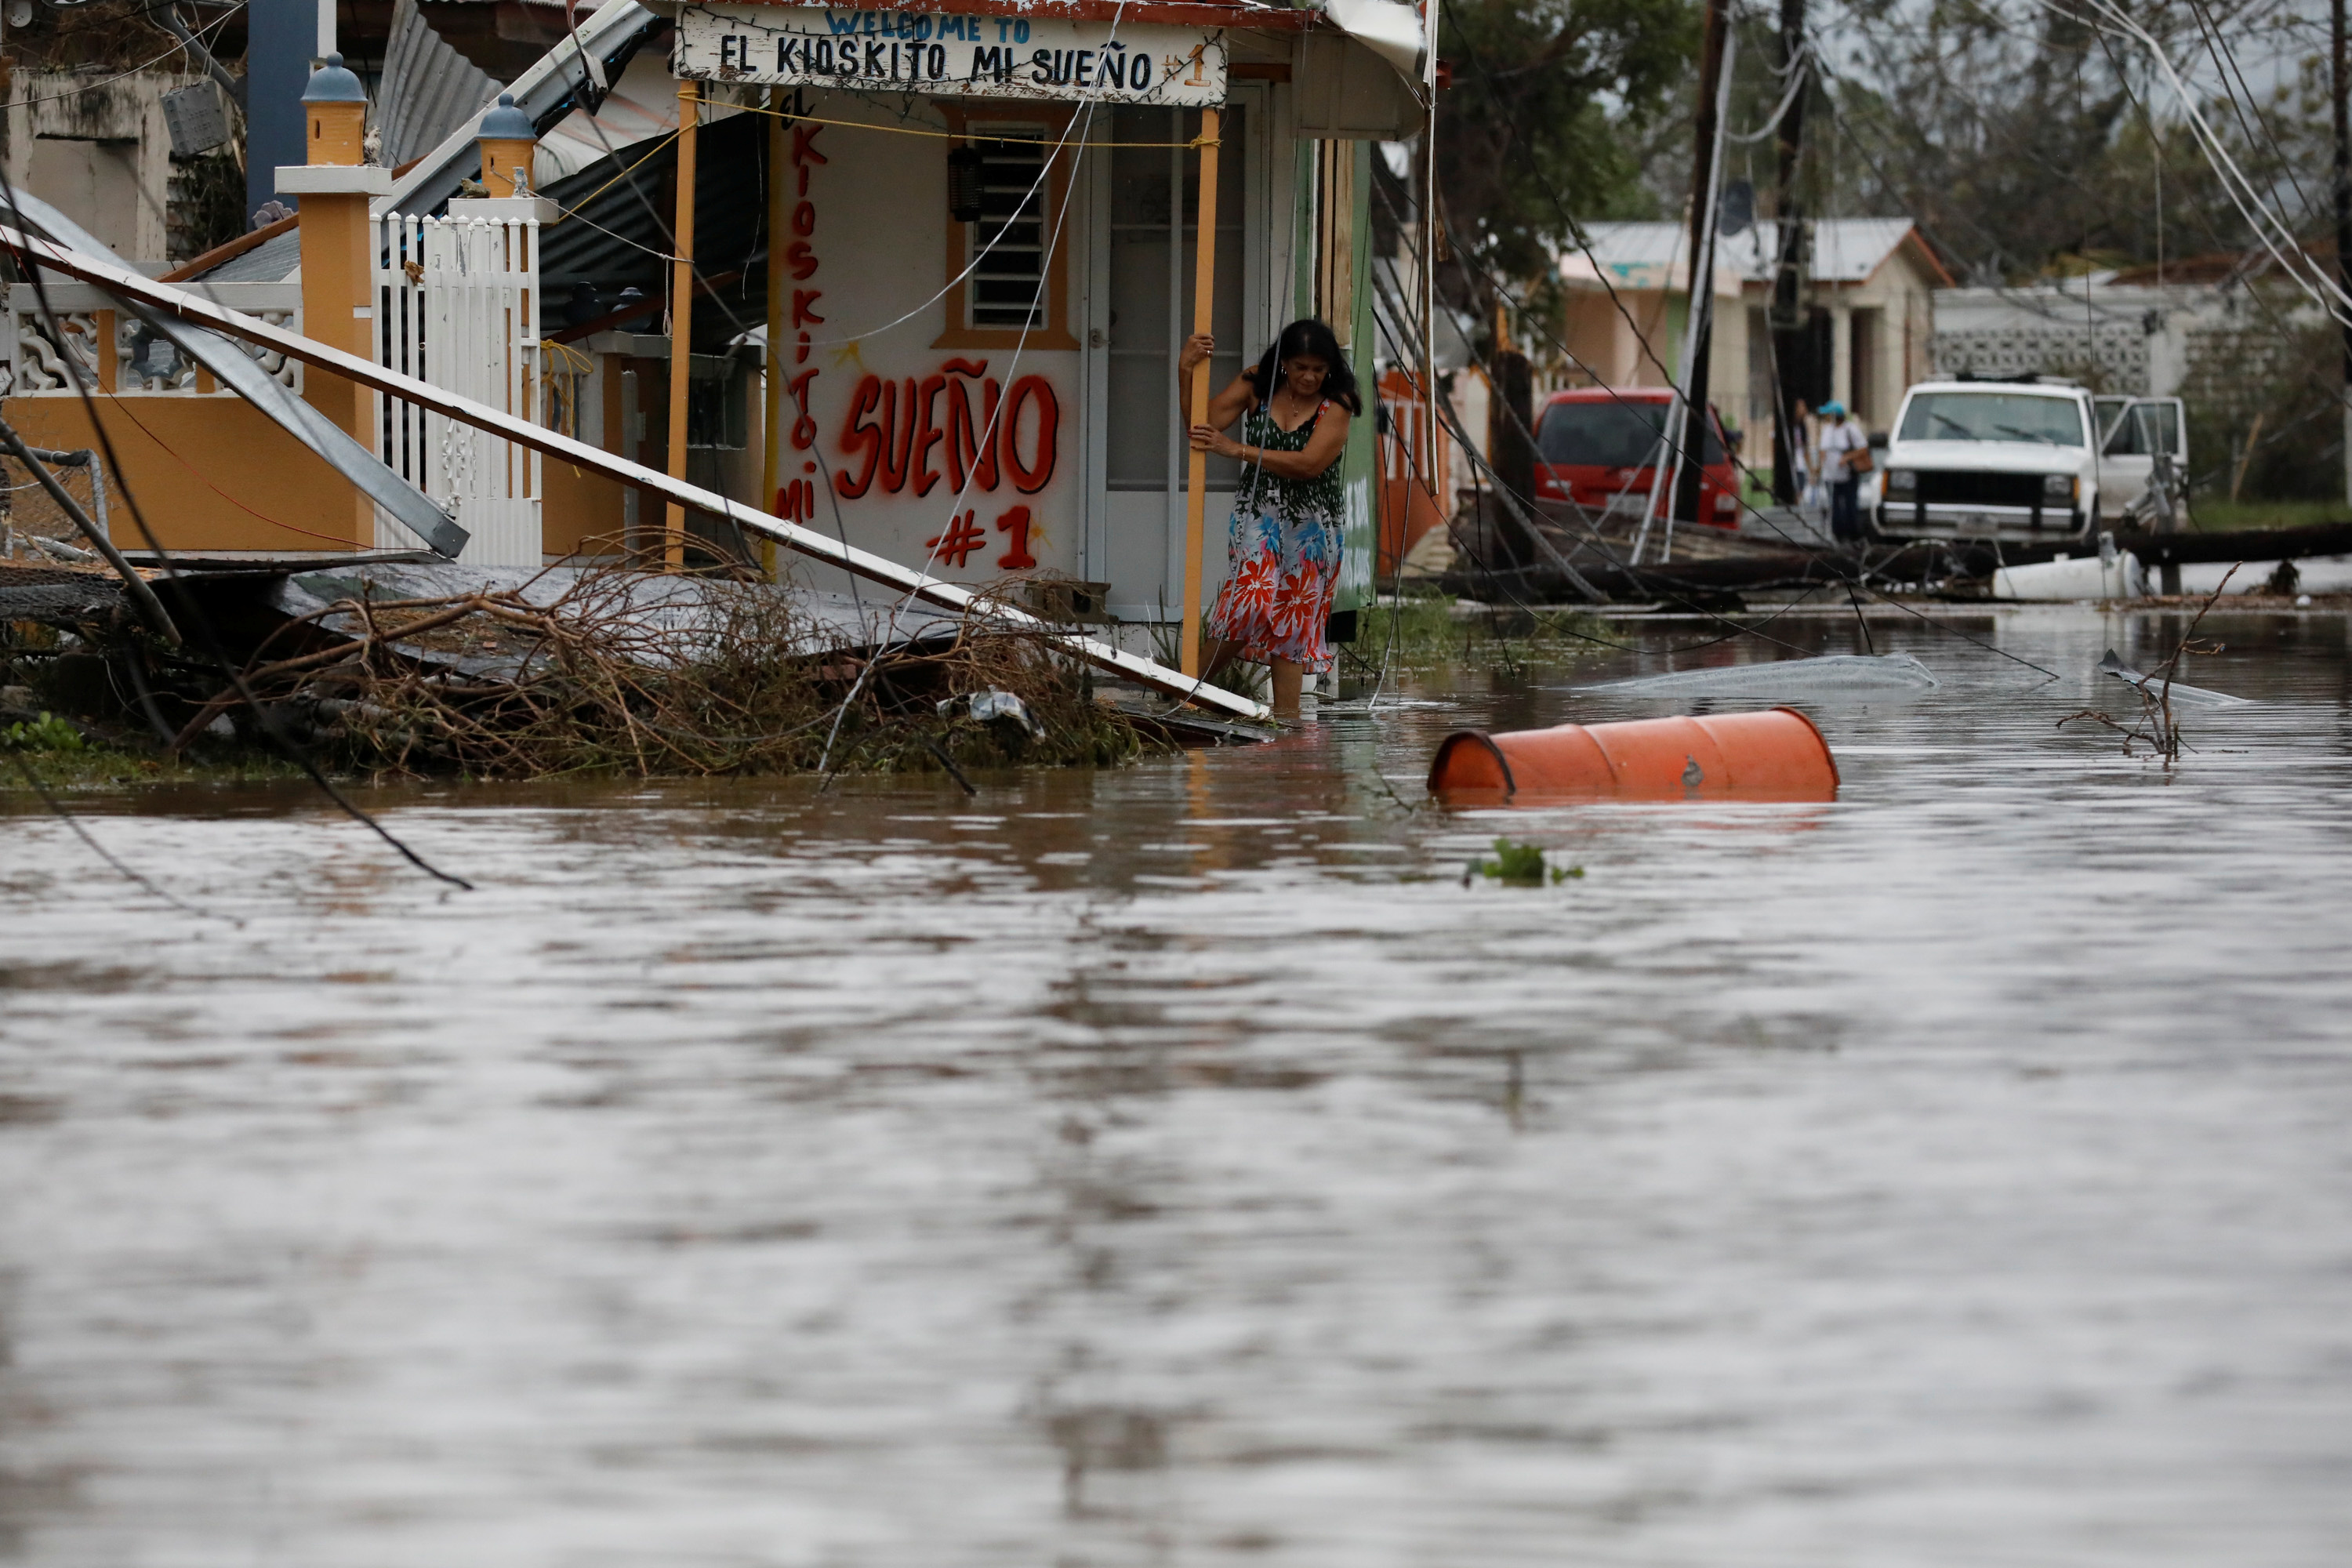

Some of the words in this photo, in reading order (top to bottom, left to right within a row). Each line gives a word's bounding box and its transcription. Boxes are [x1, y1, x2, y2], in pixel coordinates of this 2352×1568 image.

[825, 9, 982, 42] WELCOME
[994, 16, 1030, 44] TO
[720, 34, 757, 74] EL
[777, 36, 946, 80] KIOSKITO
[972, 45, 1014, 80] MI
[1031, 40, 1152, 91] SUEÑO
[1161, 44, 1212, 88] #1
[790, 124, 828, 451] KIOSKITO
[836, 357, 1061, 499] SUEÑO
[926, 505, 1037, 570] #1
